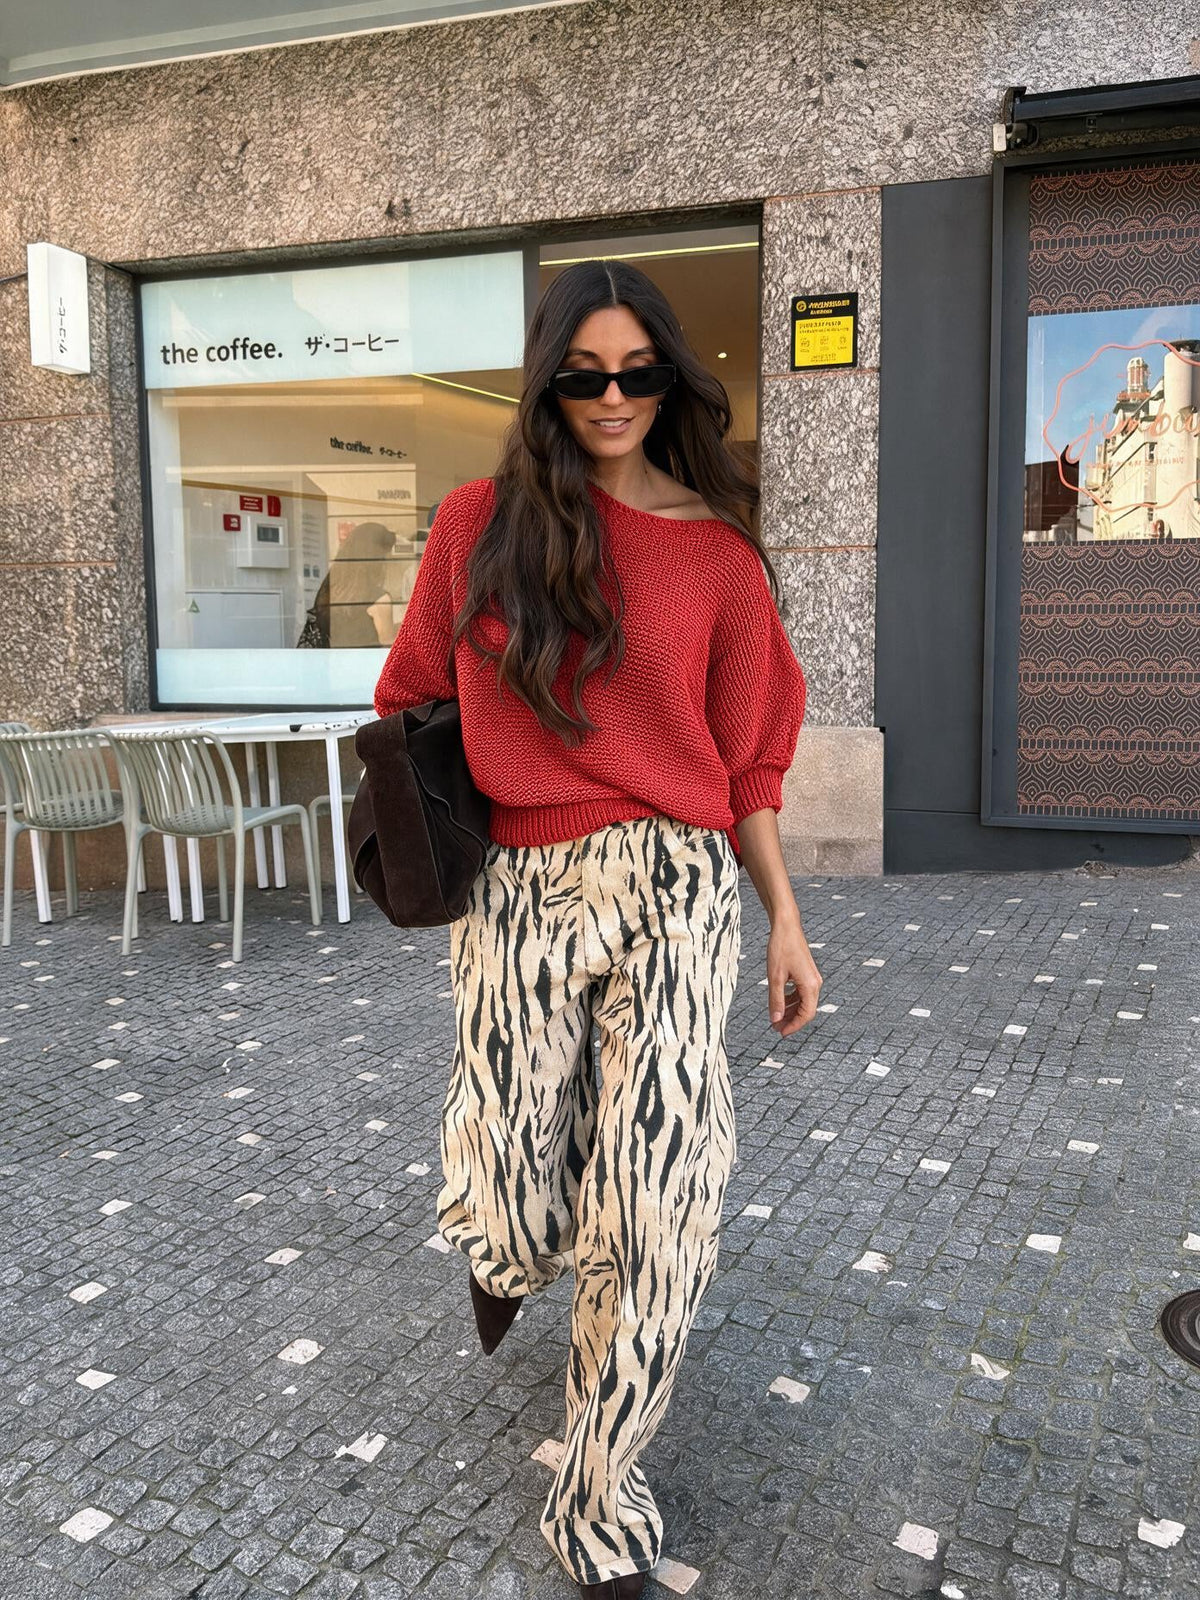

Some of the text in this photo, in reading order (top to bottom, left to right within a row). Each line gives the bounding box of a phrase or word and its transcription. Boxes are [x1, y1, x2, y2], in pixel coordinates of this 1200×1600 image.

[160, 333, 400, 365] the coffee. ザ・コーヒー
